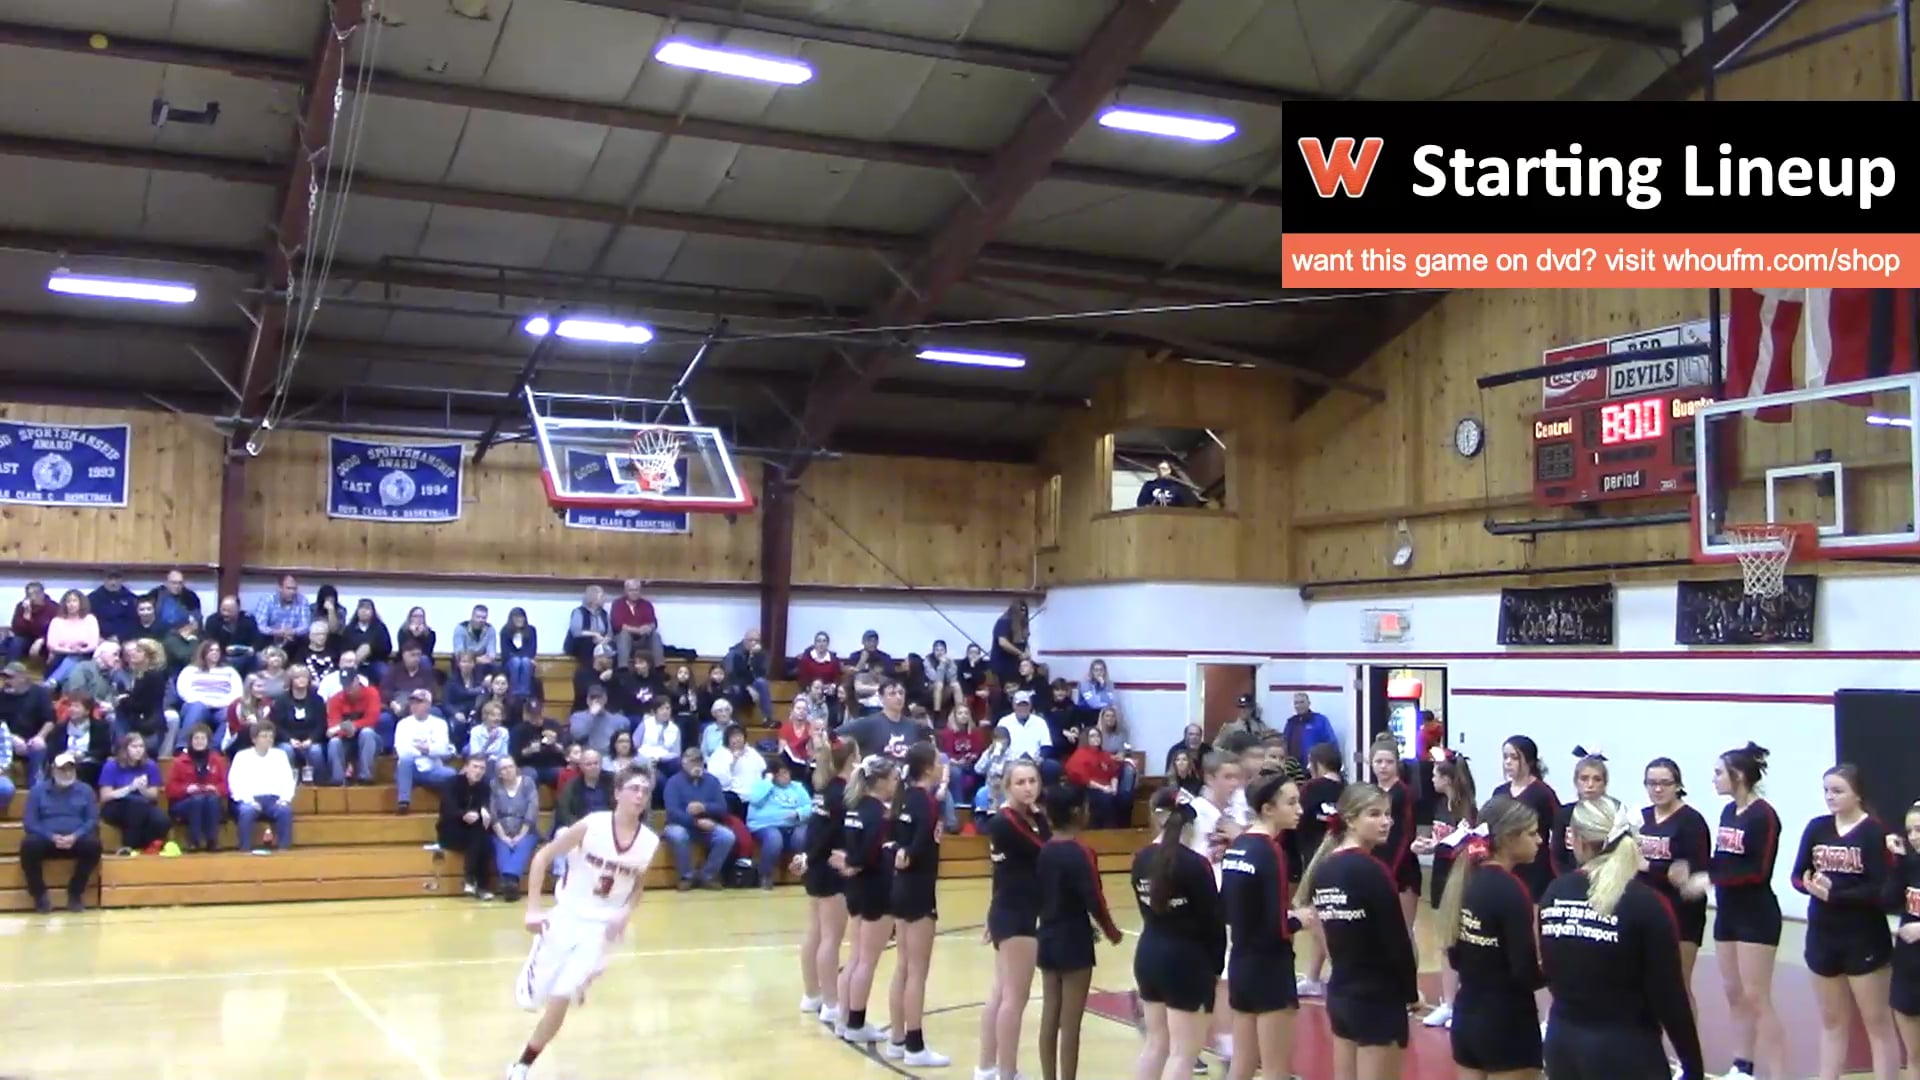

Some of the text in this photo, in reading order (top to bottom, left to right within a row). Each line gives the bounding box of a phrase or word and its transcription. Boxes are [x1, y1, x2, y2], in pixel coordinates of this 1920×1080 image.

[1614, 361, 1674, 389] DEVILS
[1535, 417, 1572, 439] Central
[1601, 399, 1663, 444] 8:00
[32, 439, 73, 451] AWARD
[377, 459, 418, 470] AWARD
[342, 480, 449, 496] EAST 1994
[1604, 470, 1640, 492] period
[1576, 924, 1618, 943] Transport
